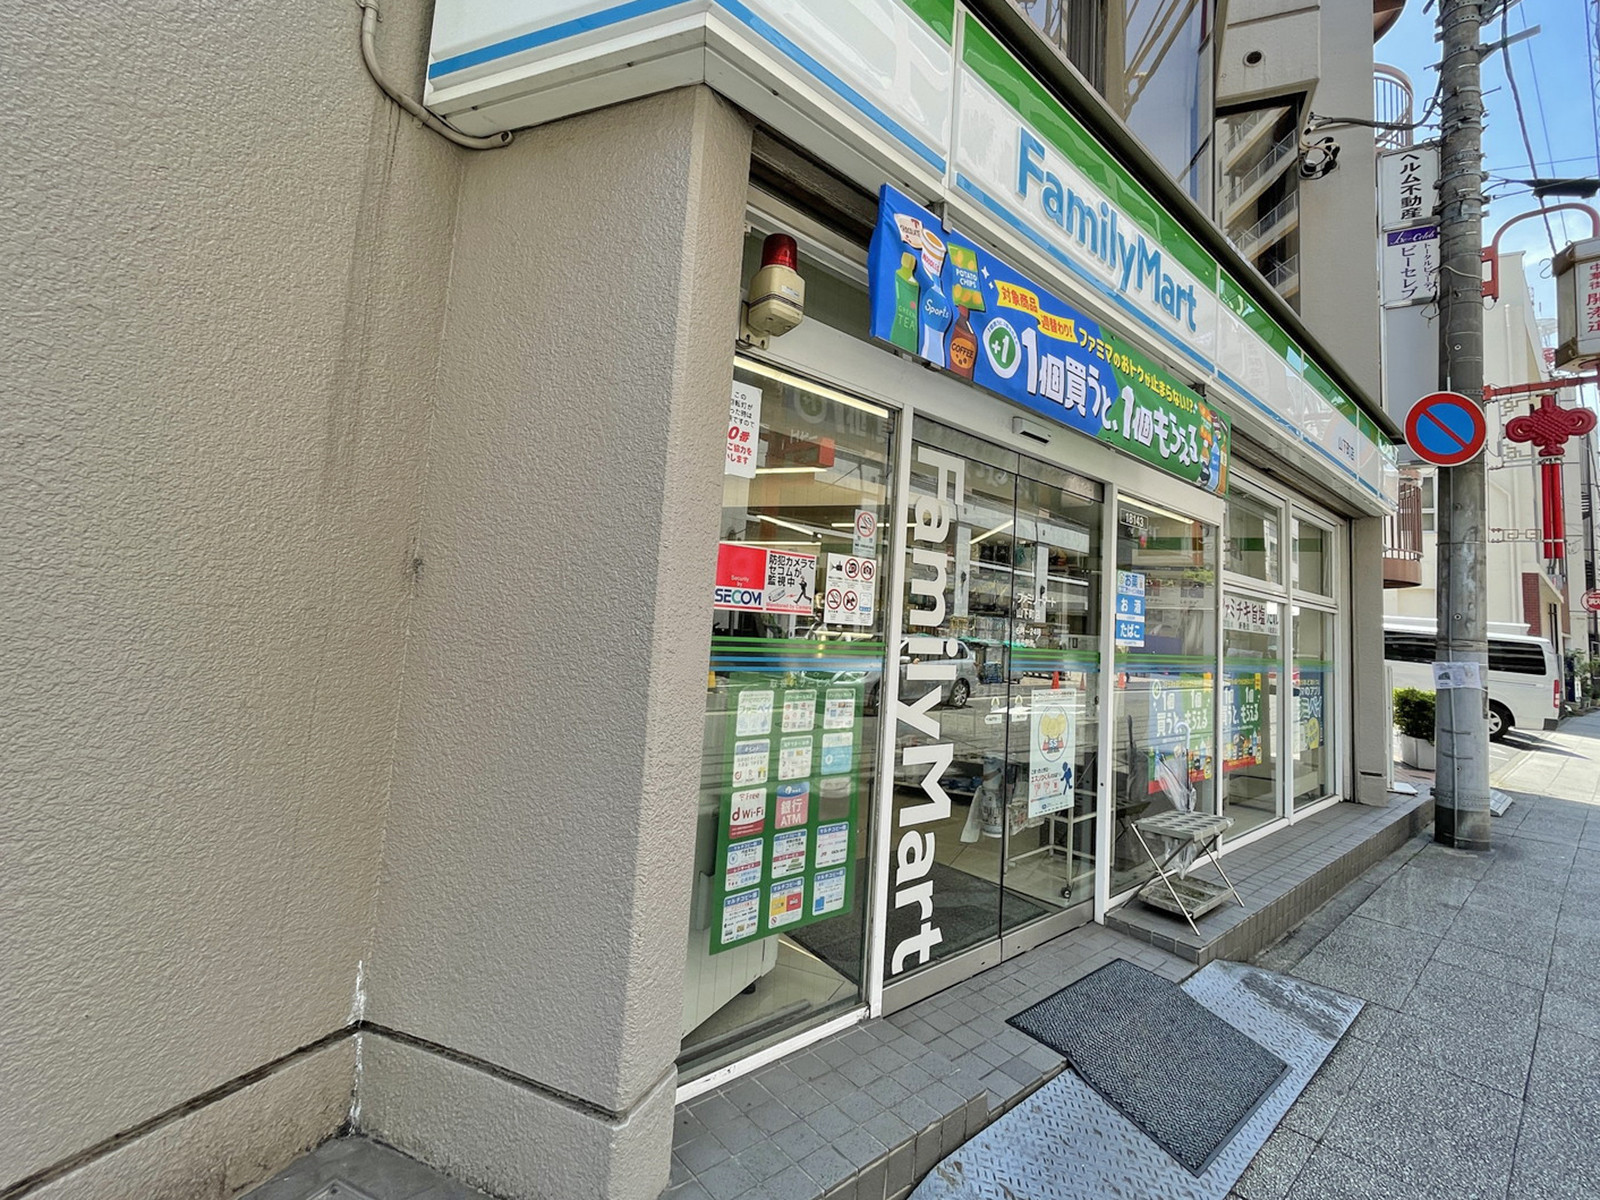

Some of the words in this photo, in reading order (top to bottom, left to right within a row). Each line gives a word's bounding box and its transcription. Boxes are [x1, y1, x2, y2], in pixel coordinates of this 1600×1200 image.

[1400, 153, 1422, 219] ヘルム不動産
[1018, 127, 1197, 332] FamilyMart
[955, 268, 978, 282] POTATO
[959, 277, 977, 289] CHIPS
[1001, 285, 1038, 314] 対象商品
[924, 299, 949, 319] Sports
[899, 314, 916, 331] TEA
[951, 342, 974, 360] COFFEE
[735, 391, 747, 400] この
[1125, 512, 1144, 528] 18143
[769, 554, 815, 569] 防犯カメラで
[731, 574, 750, 583] Security
[769, 564, 802, 578] セコムが
[768, 575, 795, 587] 監視中
[714, 588, 762, 605] SECOM
[1120, 622, 1140, 638] たばこ
[891, 446, 965, 975] FamilyMart
[742, 807, 763, 819] Wi-Fi
[781, 799, 802, 814] 銀行
[781, 812, 802, 827] ATM
